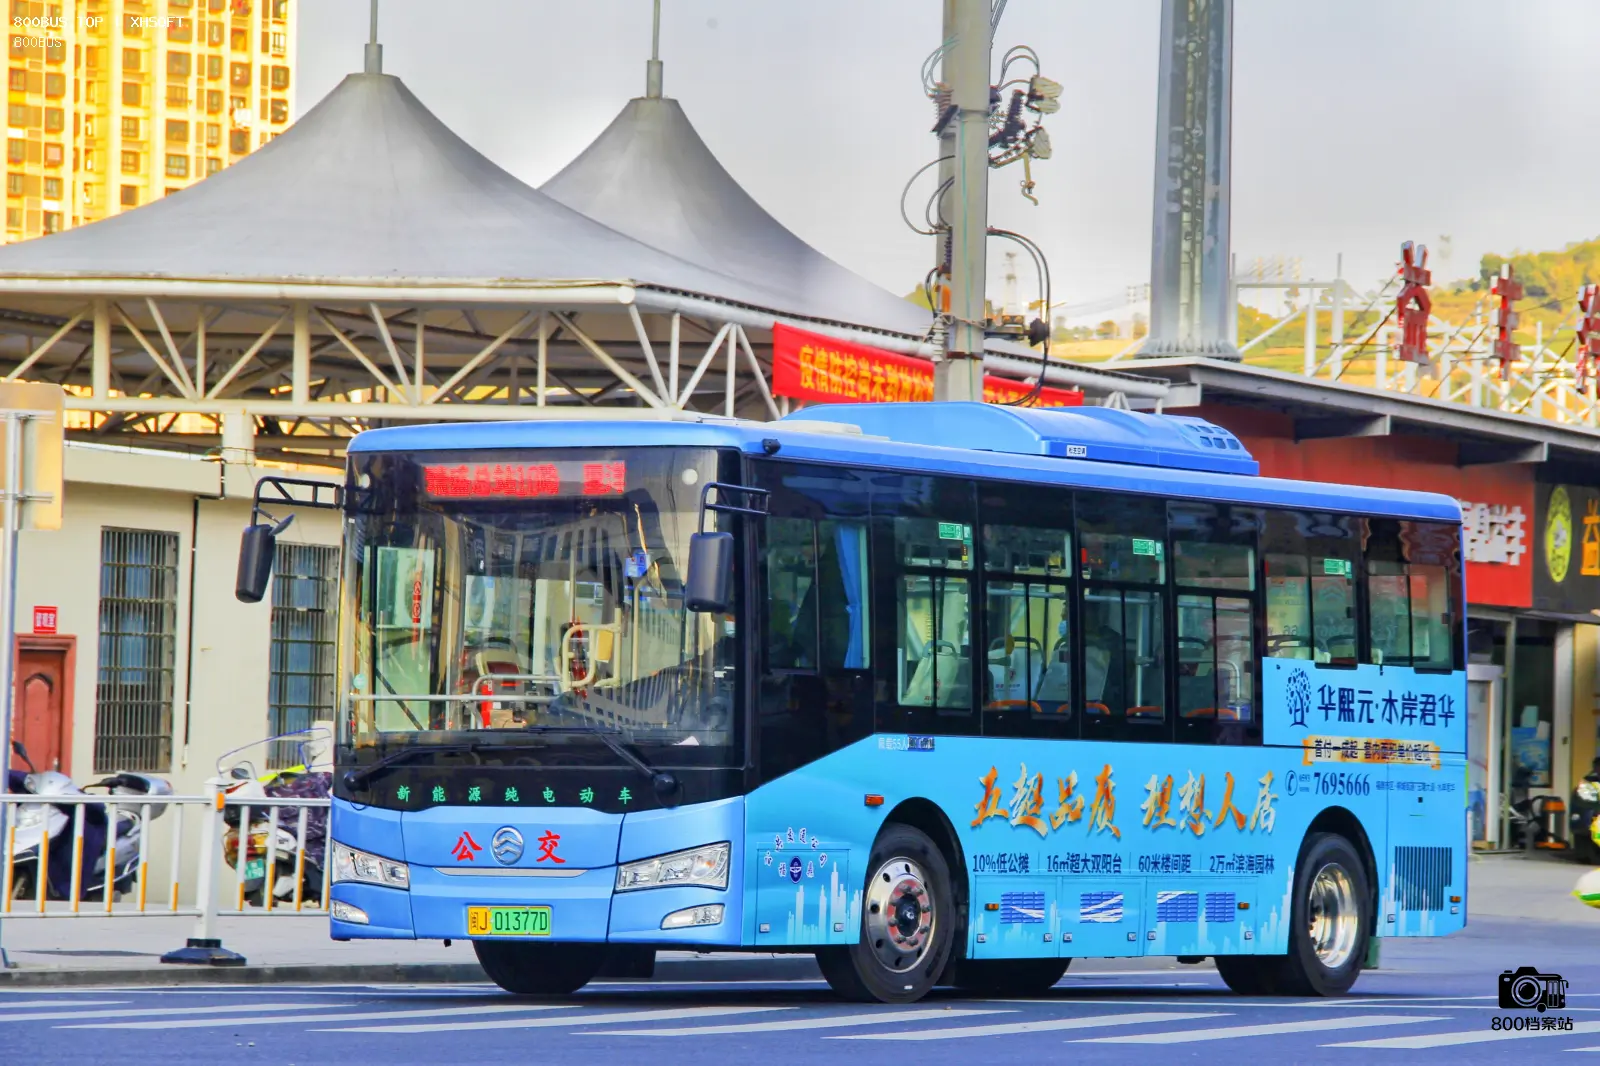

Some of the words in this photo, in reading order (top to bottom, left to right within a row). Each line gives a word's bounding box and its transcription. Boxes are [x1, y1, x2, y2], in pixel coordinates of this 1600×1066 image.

[396, 785, 633, 804] 新能源纯电动车
[1313, 772, 1371, 796] 7695666
[1140, 769, 1278, 836] 理想人居
[1138, 853, 1192, 873] 60米楼间距
